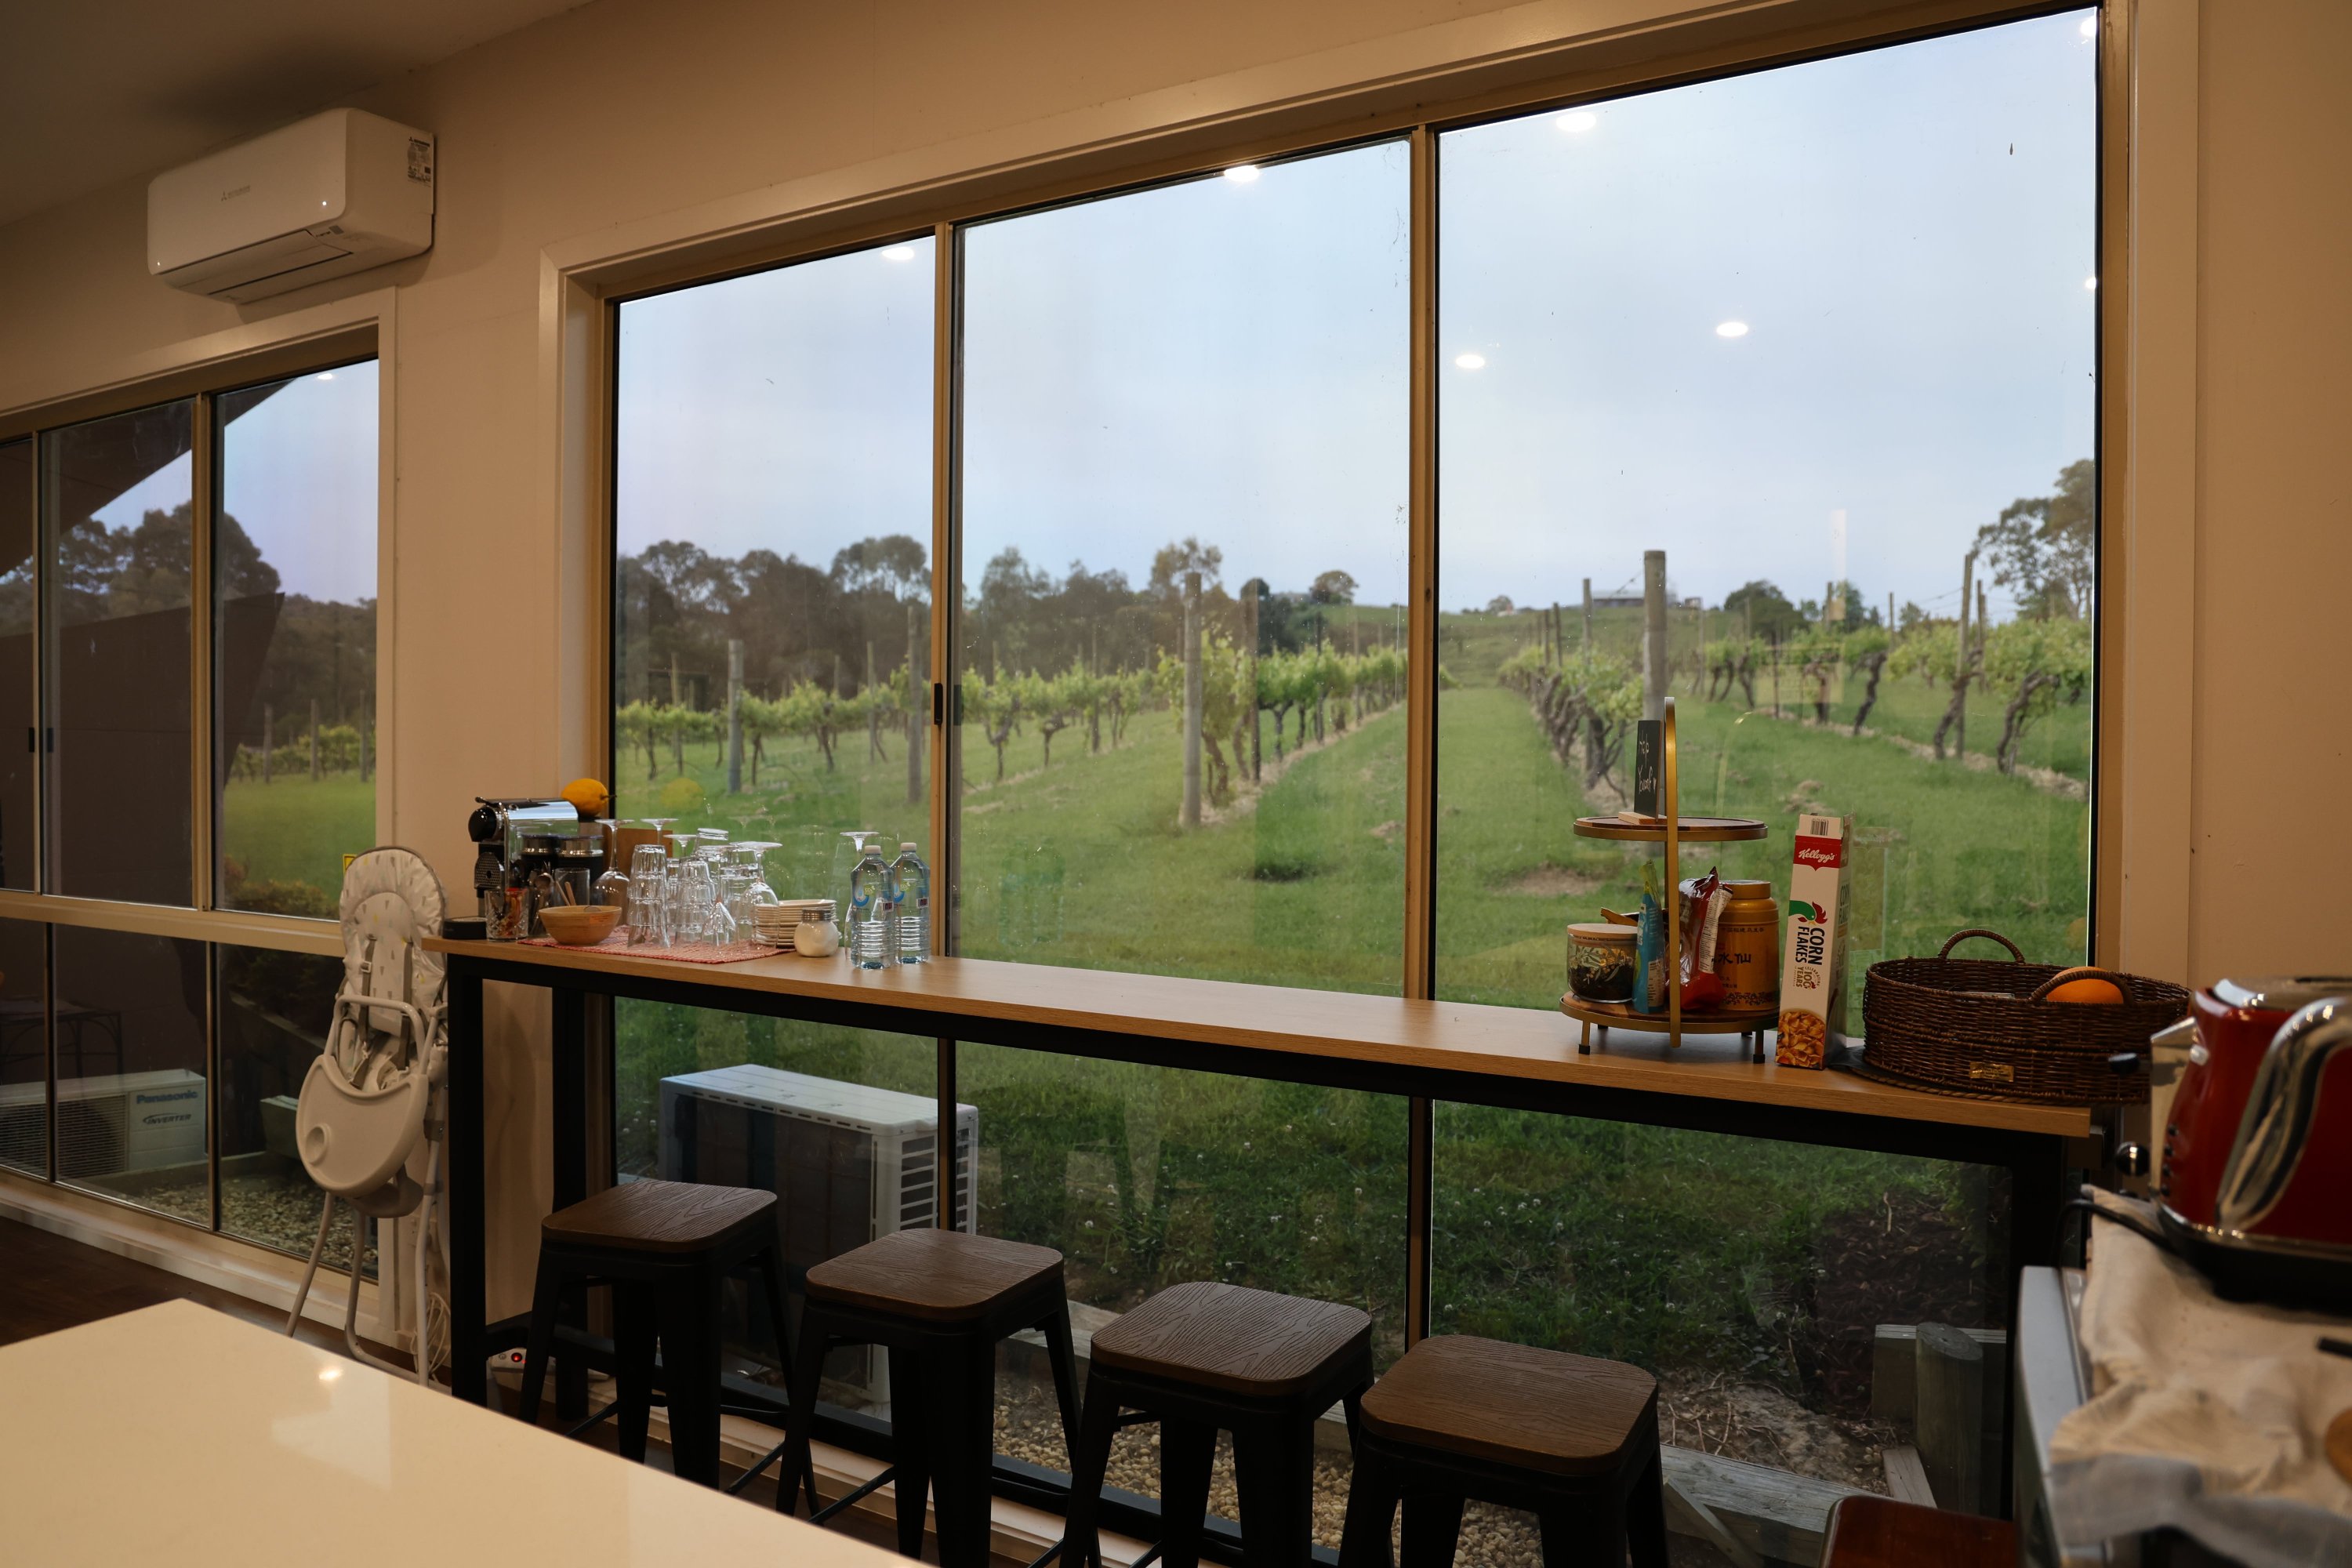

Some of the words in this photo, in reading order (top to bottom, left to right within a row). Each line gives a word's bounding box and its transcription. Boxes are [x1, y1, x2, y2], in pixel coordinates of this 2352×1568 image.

[1798, 848, 1835, 862] Kellogg's
[1795, 927, 1809, 963] FLAKES
[1808, 927, 1824, 965] CORN
[1718, 952, 1751, 964] 水仙
[1795, 966, 1804, 988] YEARS
[1802, 971, 1813, 989] 100
[136, 1090, 198, 1104] Panasonic
[146, 1114, 191, 1124] INVERTER
